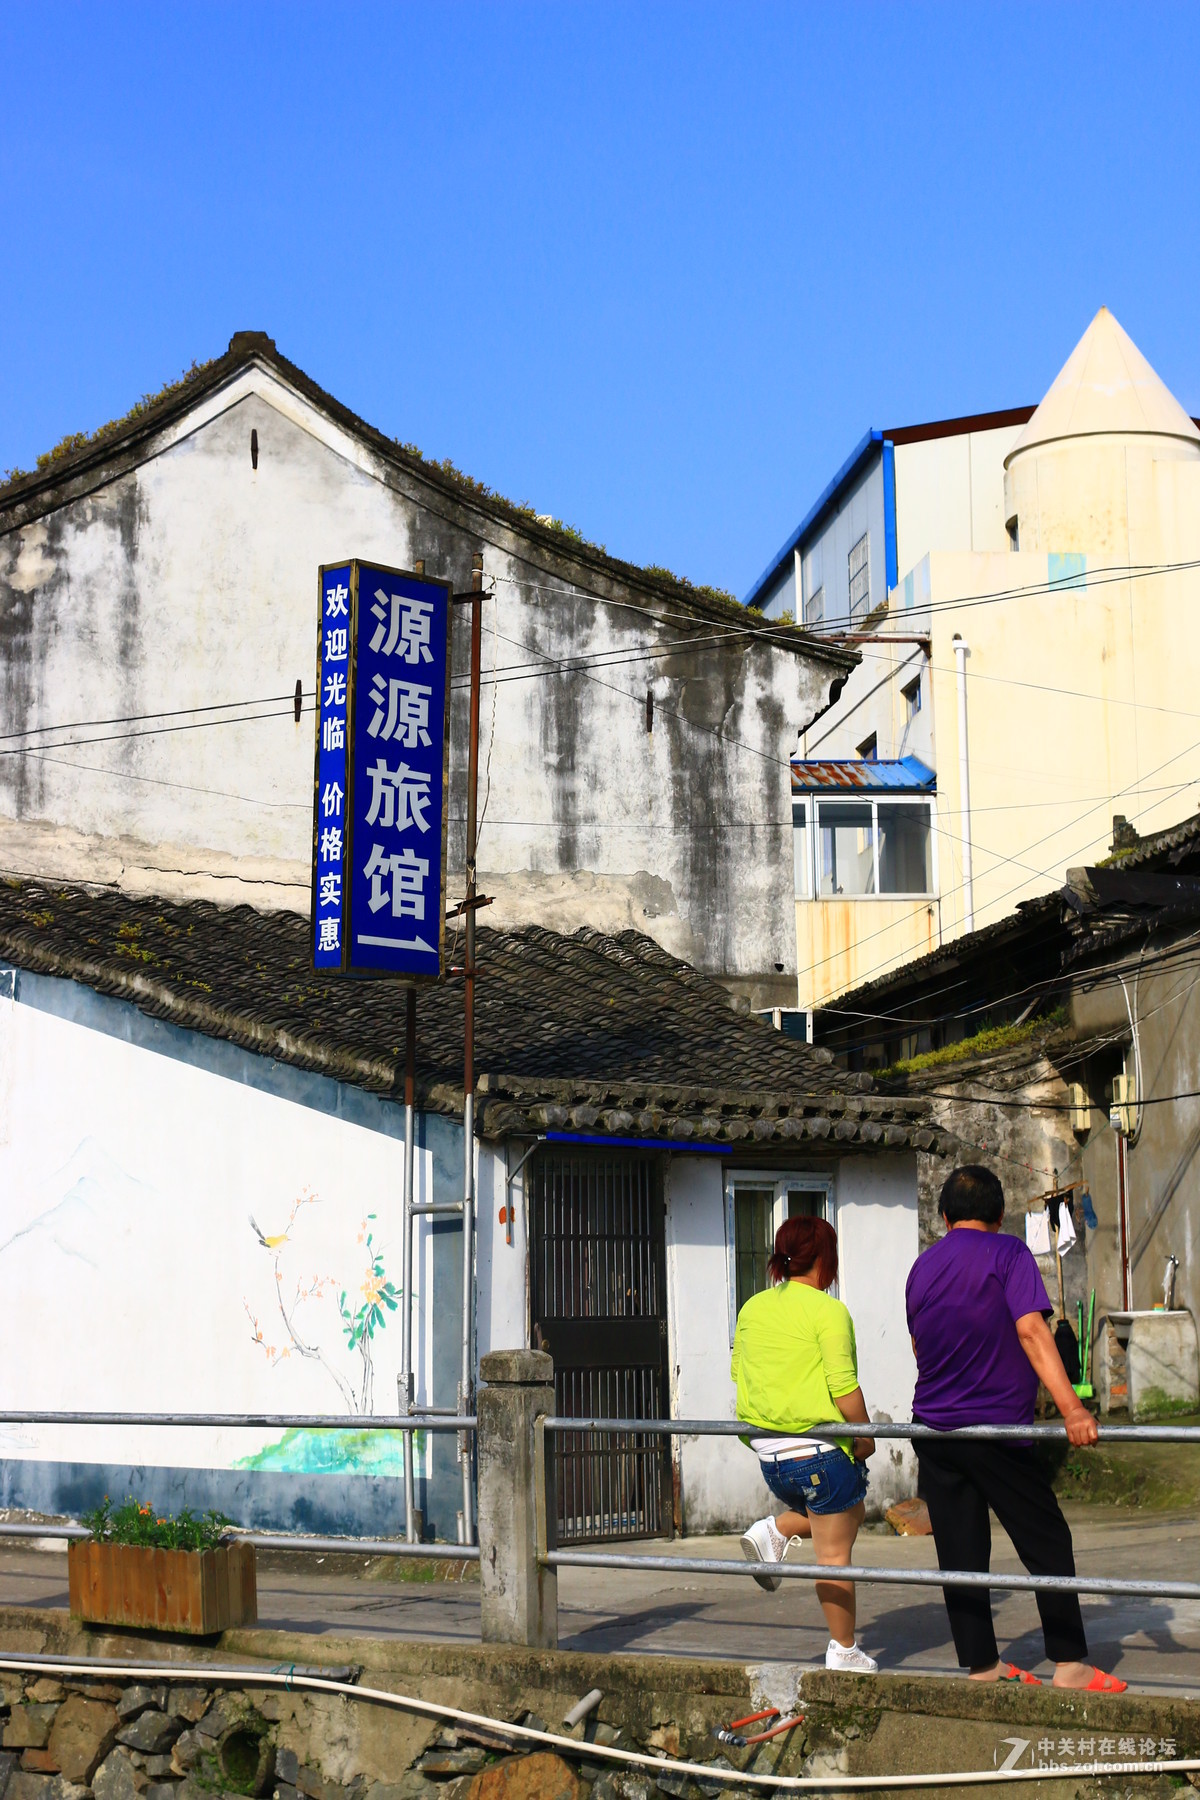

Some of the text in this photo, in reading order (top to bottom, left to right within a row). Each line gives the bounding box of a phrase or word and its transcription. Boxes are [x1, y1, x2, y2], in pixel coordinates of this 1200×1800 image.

[318, 584, 349, 952] 欢迎光临 价格实惠
[363, 588, 434, 921] 源源旅馆
